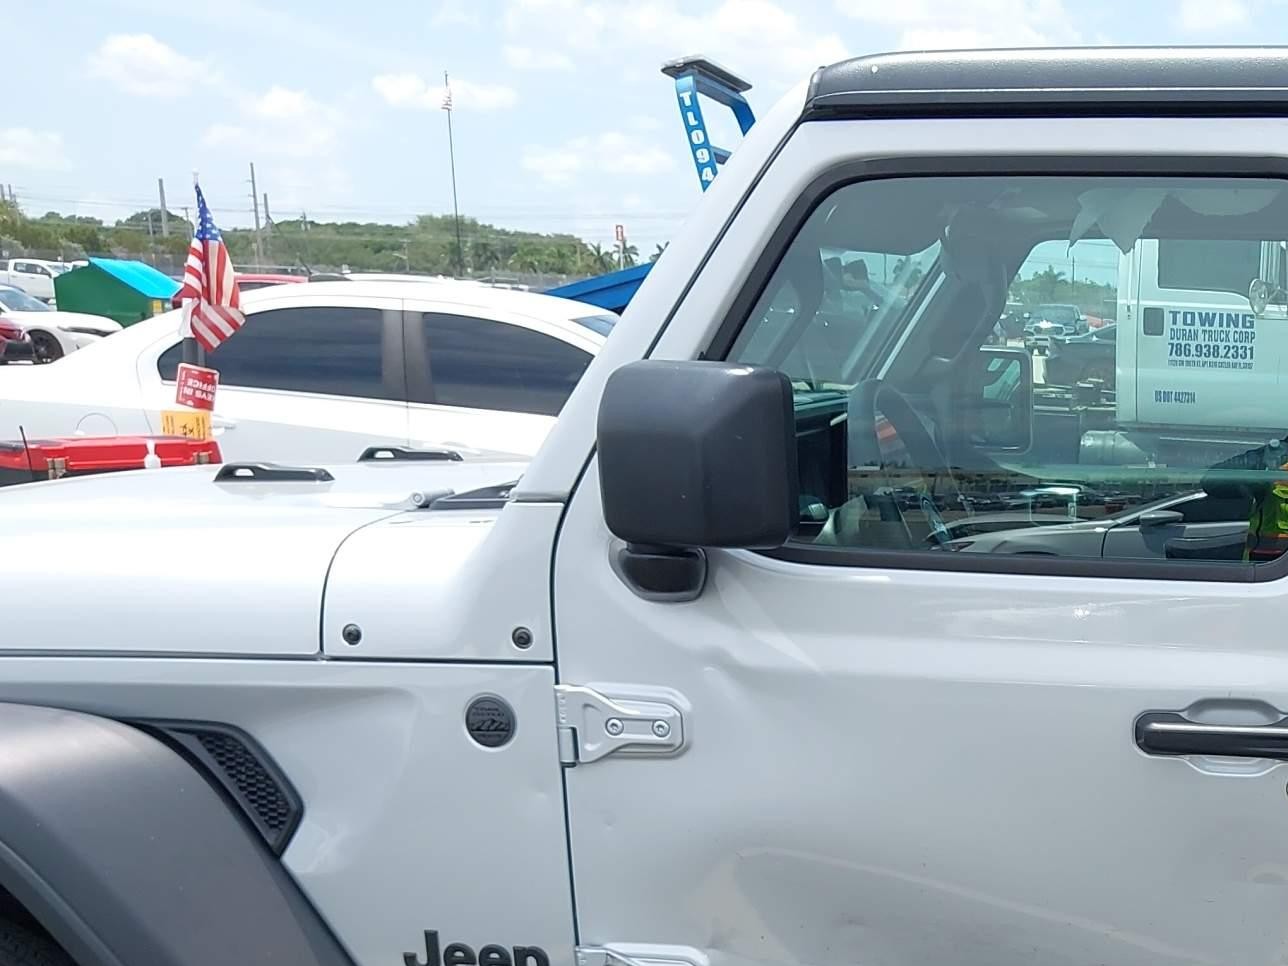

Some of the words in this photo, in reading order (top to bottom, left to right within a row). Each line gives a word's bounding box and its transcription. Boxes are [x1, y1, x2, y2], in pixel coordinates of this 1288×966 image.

[1168, 310, 1255, 329] TOWING
[1169, 328, 1199, 342] DURAN
[1202, 329, 1230, 343] TRUCK
[1233, 330, 1256, 344] CORP
[1167, 342, 1254, 360] 786.938.2331
[187, 377, 216, 393] OFFICE
